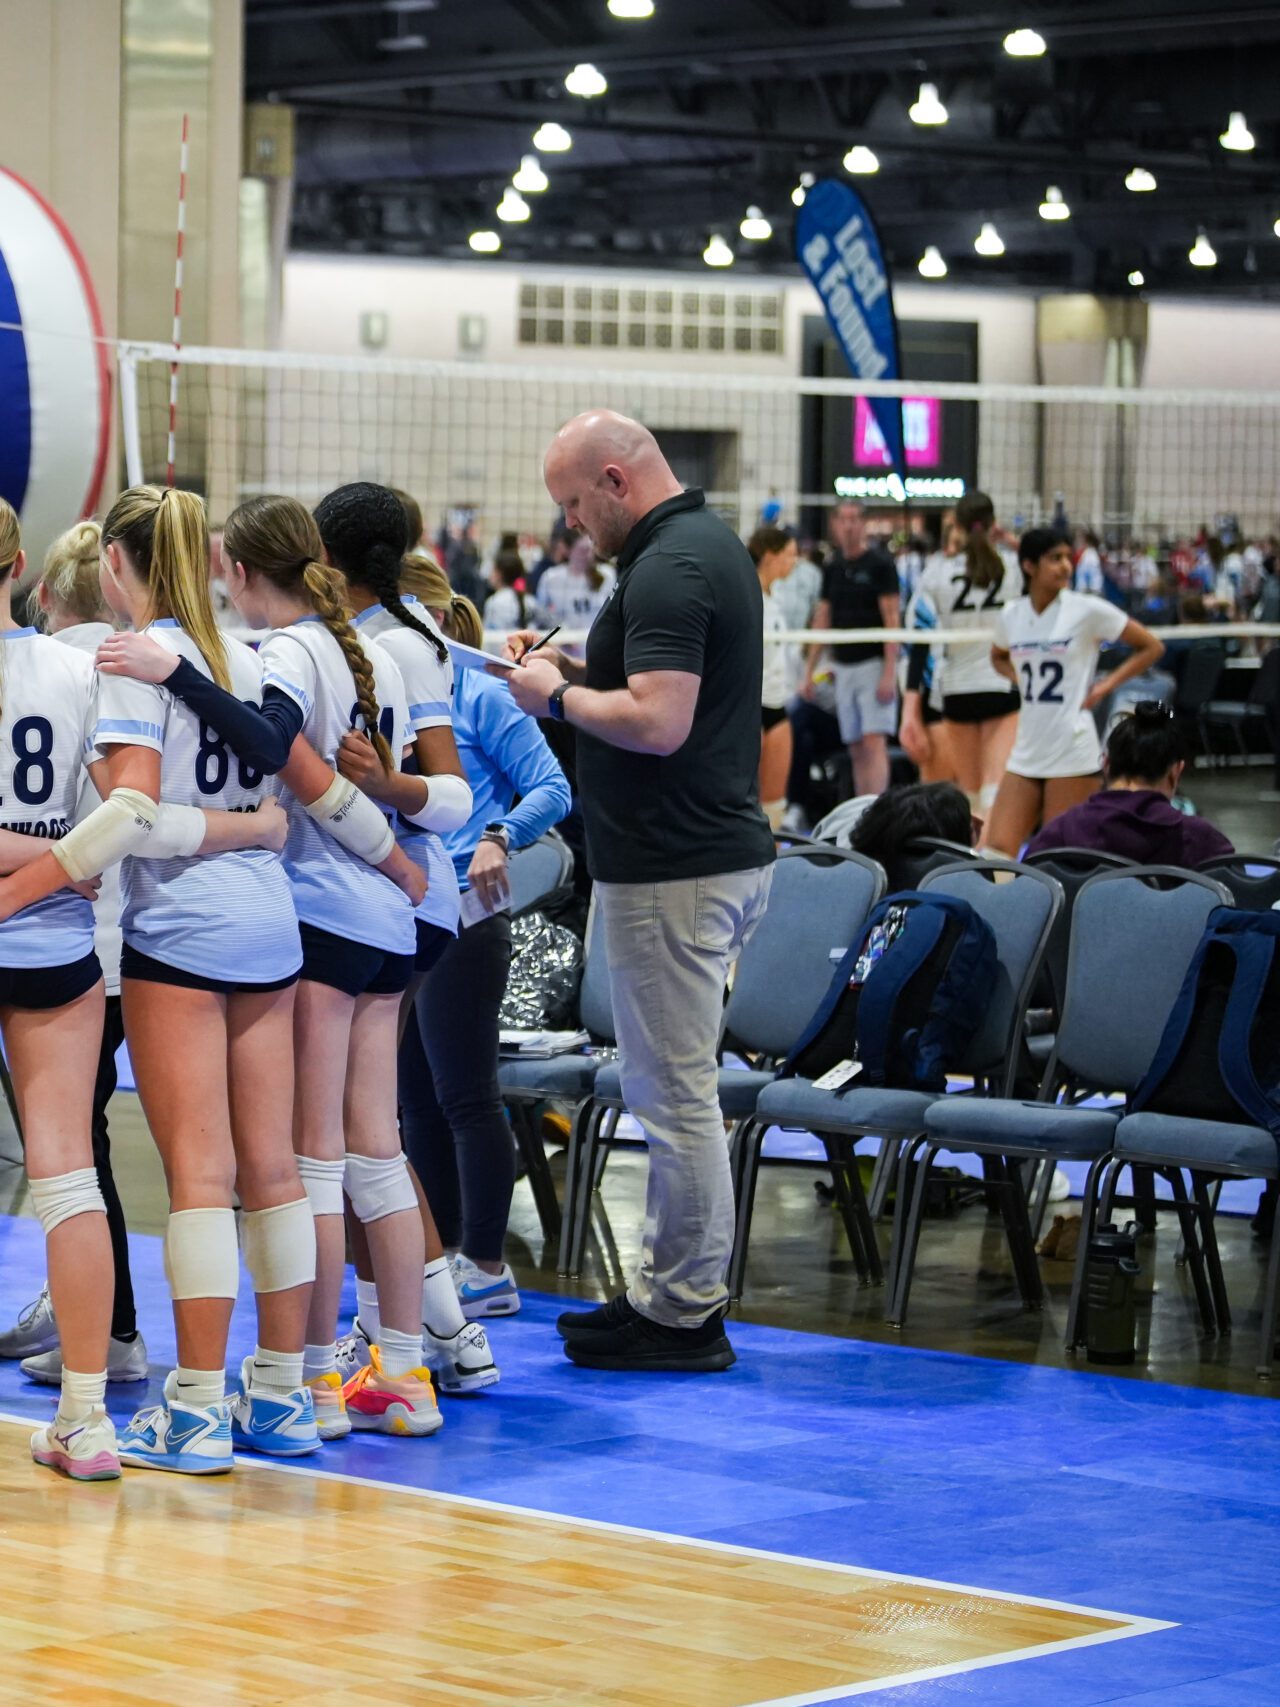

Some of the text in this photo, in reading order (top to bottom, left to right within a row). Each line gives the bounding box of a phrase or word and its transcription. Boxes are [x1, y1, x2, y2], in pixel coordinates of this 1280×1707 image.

[834, 214, 887, 310] Lost
[951, 575, 1004, 612] 22
[1022, 661, 1064, 703] 12
